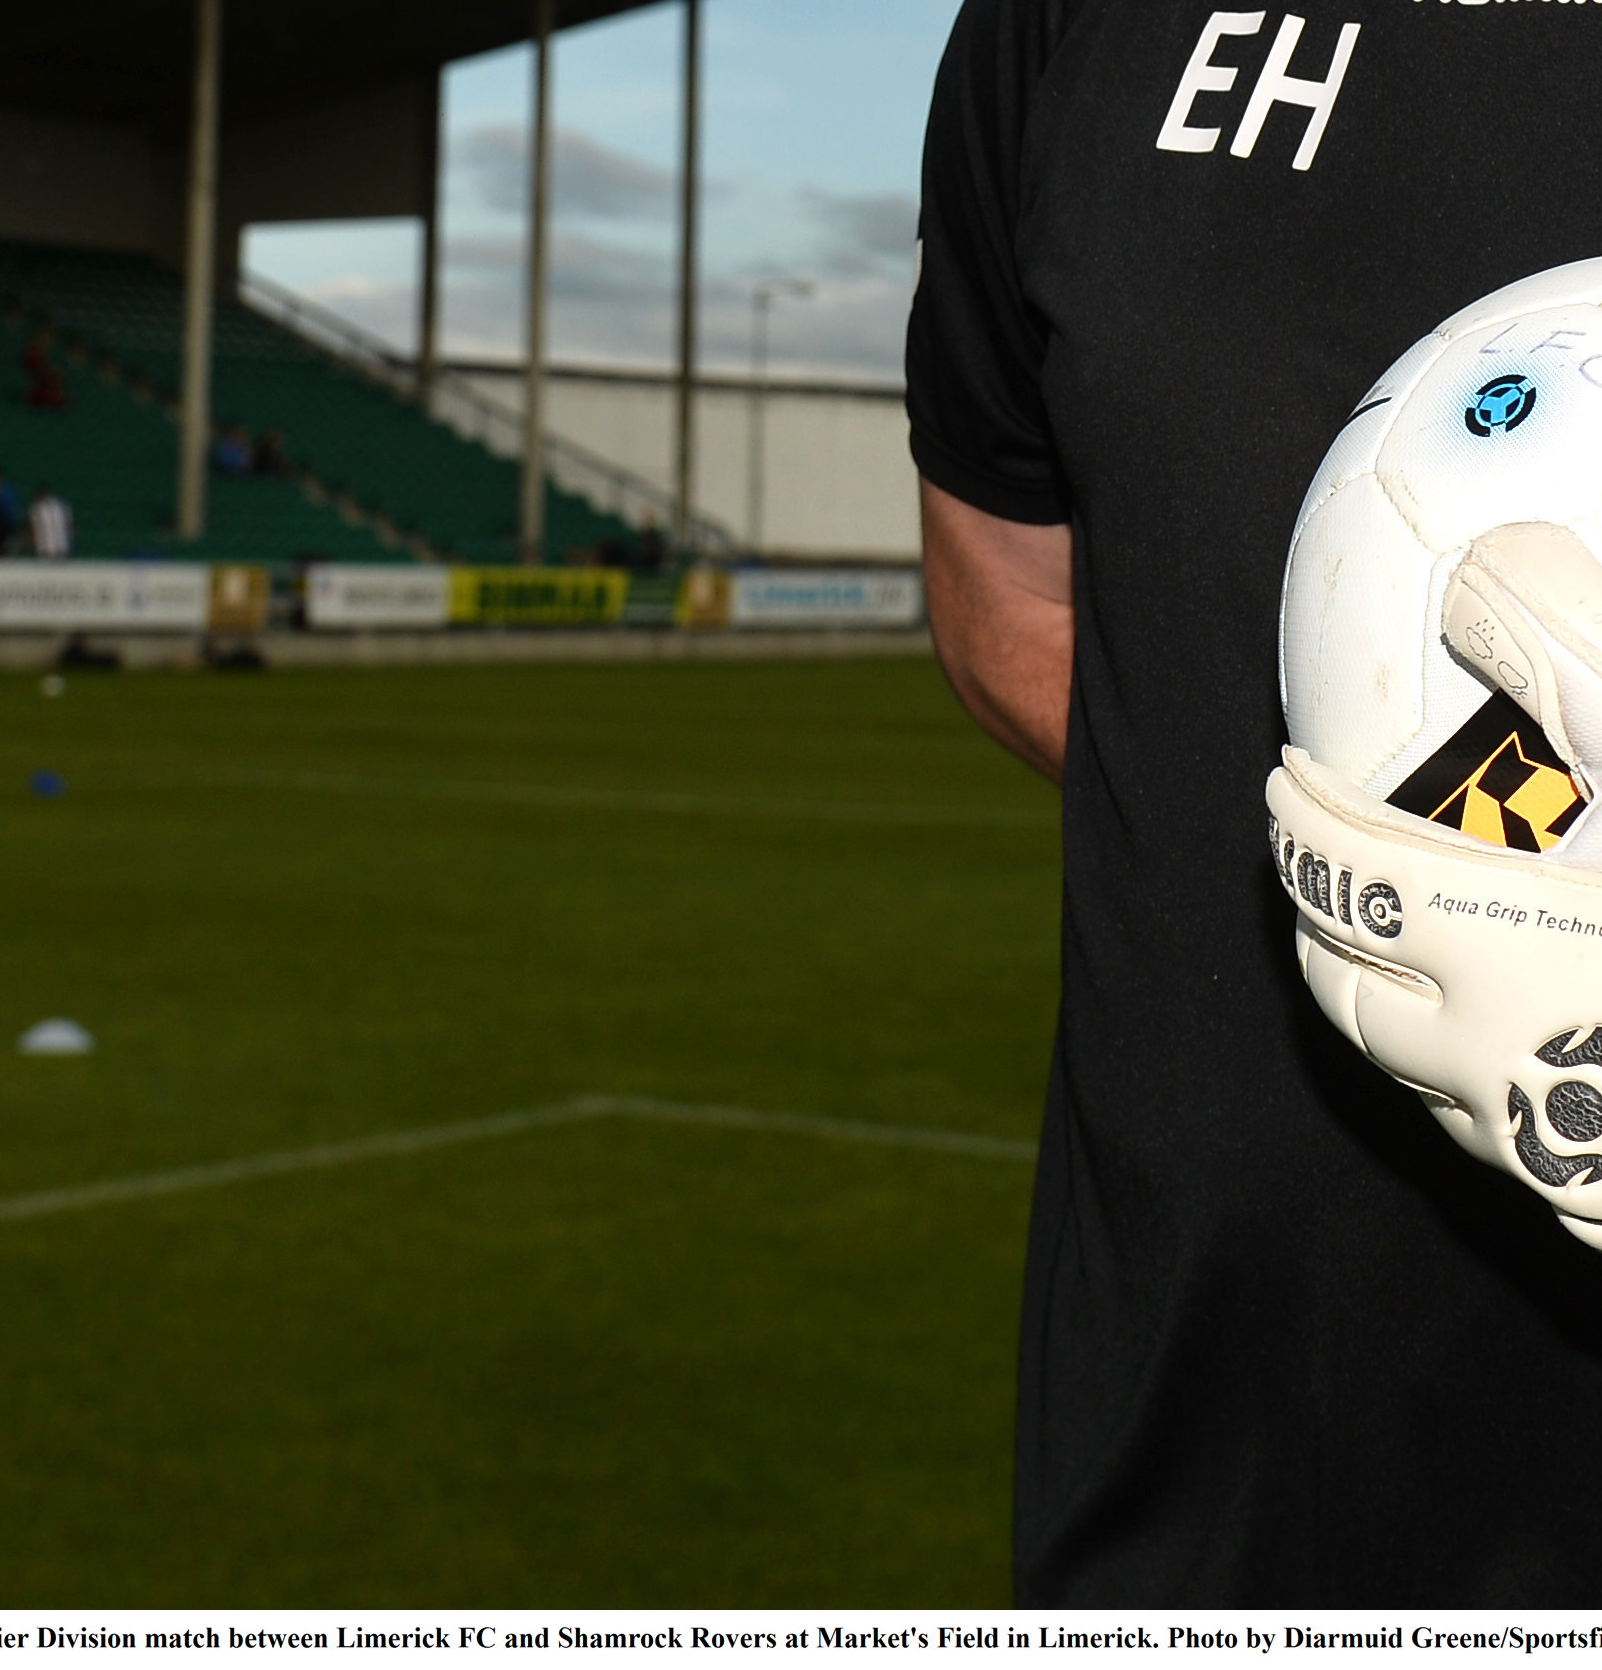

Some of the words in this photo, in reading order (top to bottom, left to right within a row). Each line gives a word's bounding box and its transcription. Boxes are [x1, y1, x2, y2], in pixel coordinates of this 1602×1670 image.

[1155, 10, 1362, 171] EH
[1428, 892, 1479, 915] Aqua
[1486, 901, 1528, 927] Grip
